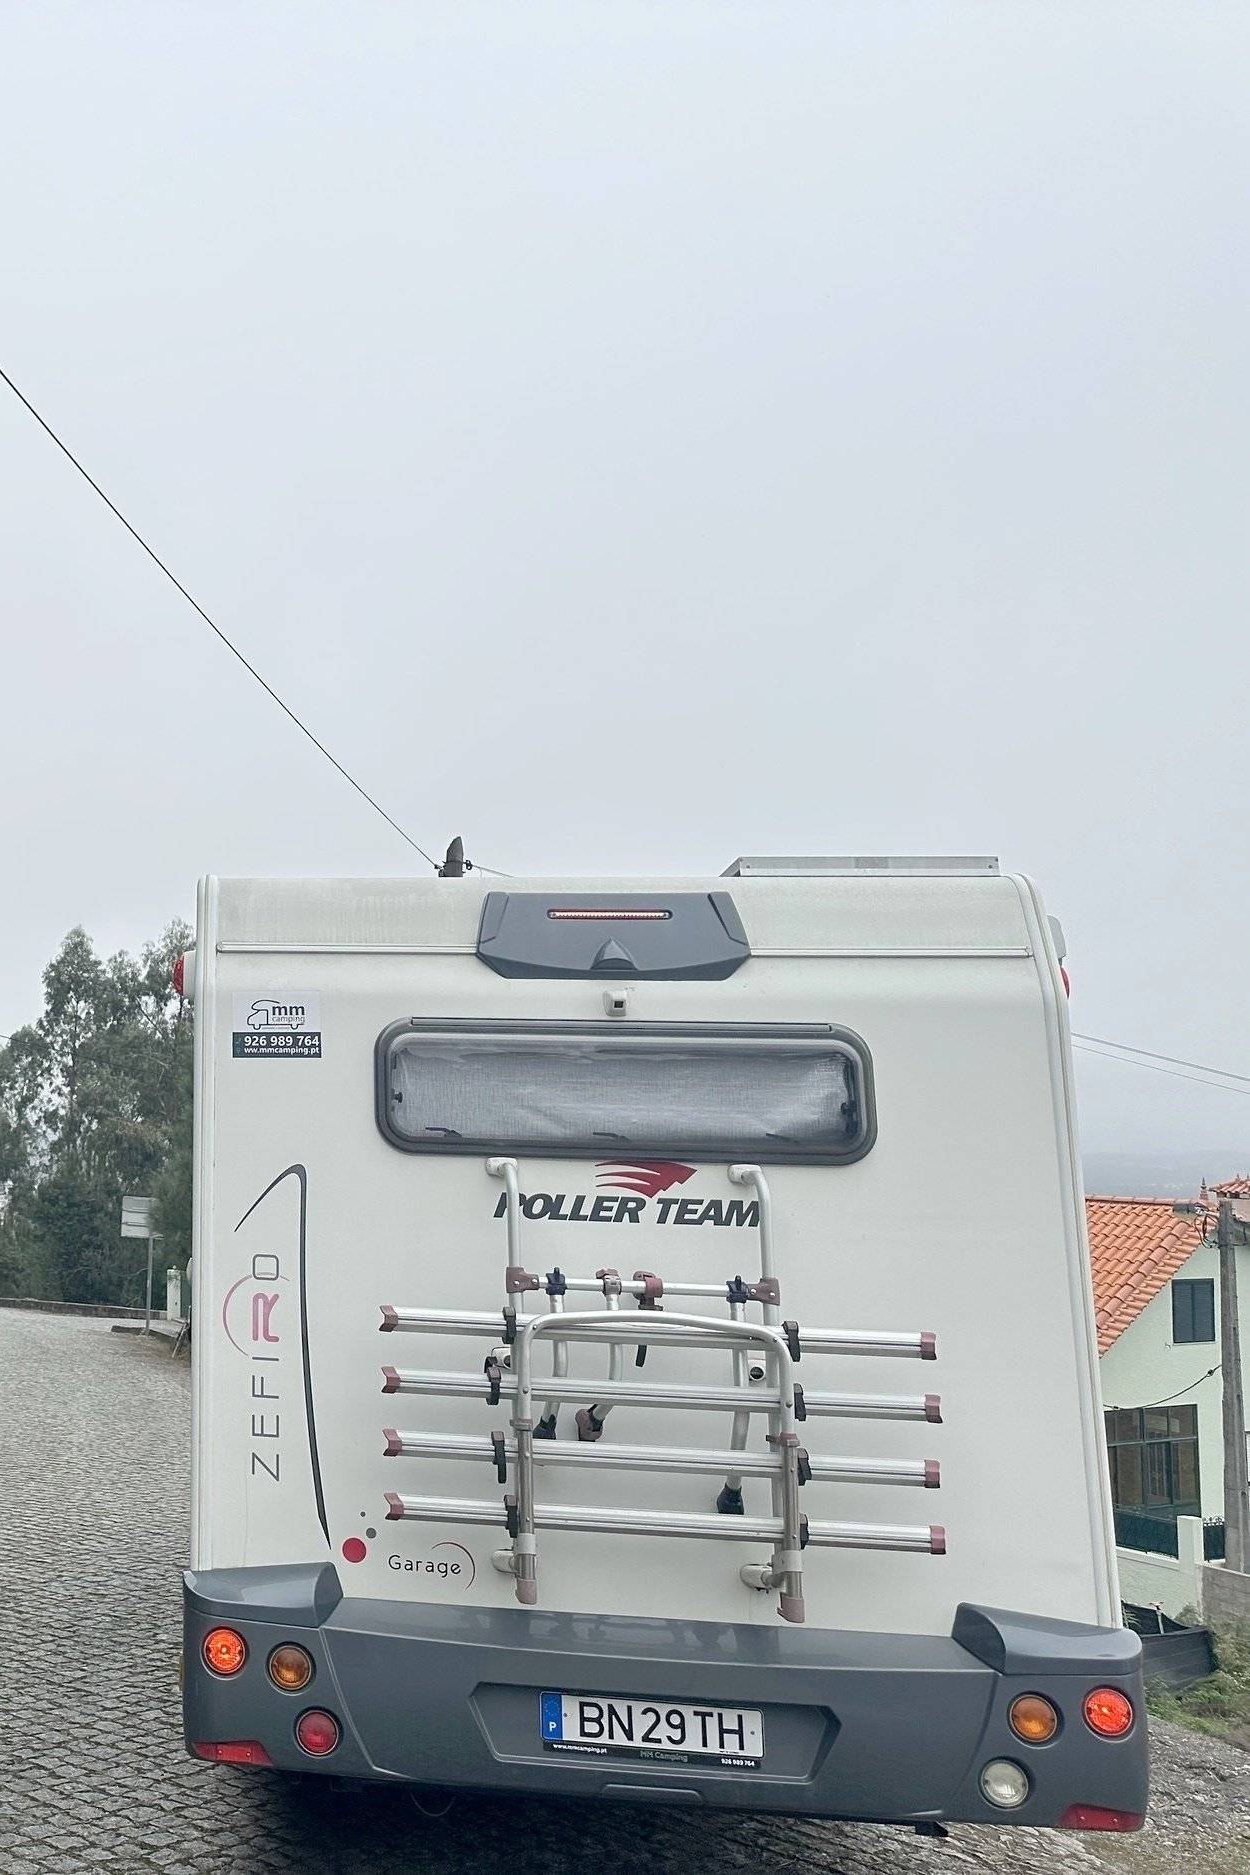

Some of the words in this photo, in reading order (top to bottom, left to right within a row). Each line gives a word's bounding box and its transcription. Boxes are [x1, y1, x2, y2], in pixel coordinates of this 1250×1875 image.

[271, 1005, 305, 1016] mm
[244, 1035, 267, 1046] 926
[270, 1035, 293, 1046] 989
[296, 1035, 319, 1046] 764
[656, 1197, 760, 1227] TEAM
[251, 1253, 280, 1482] ZEFIRO
[388, 1554, 462, 1578] Garage
[549, 1721, 557, 1732] P
